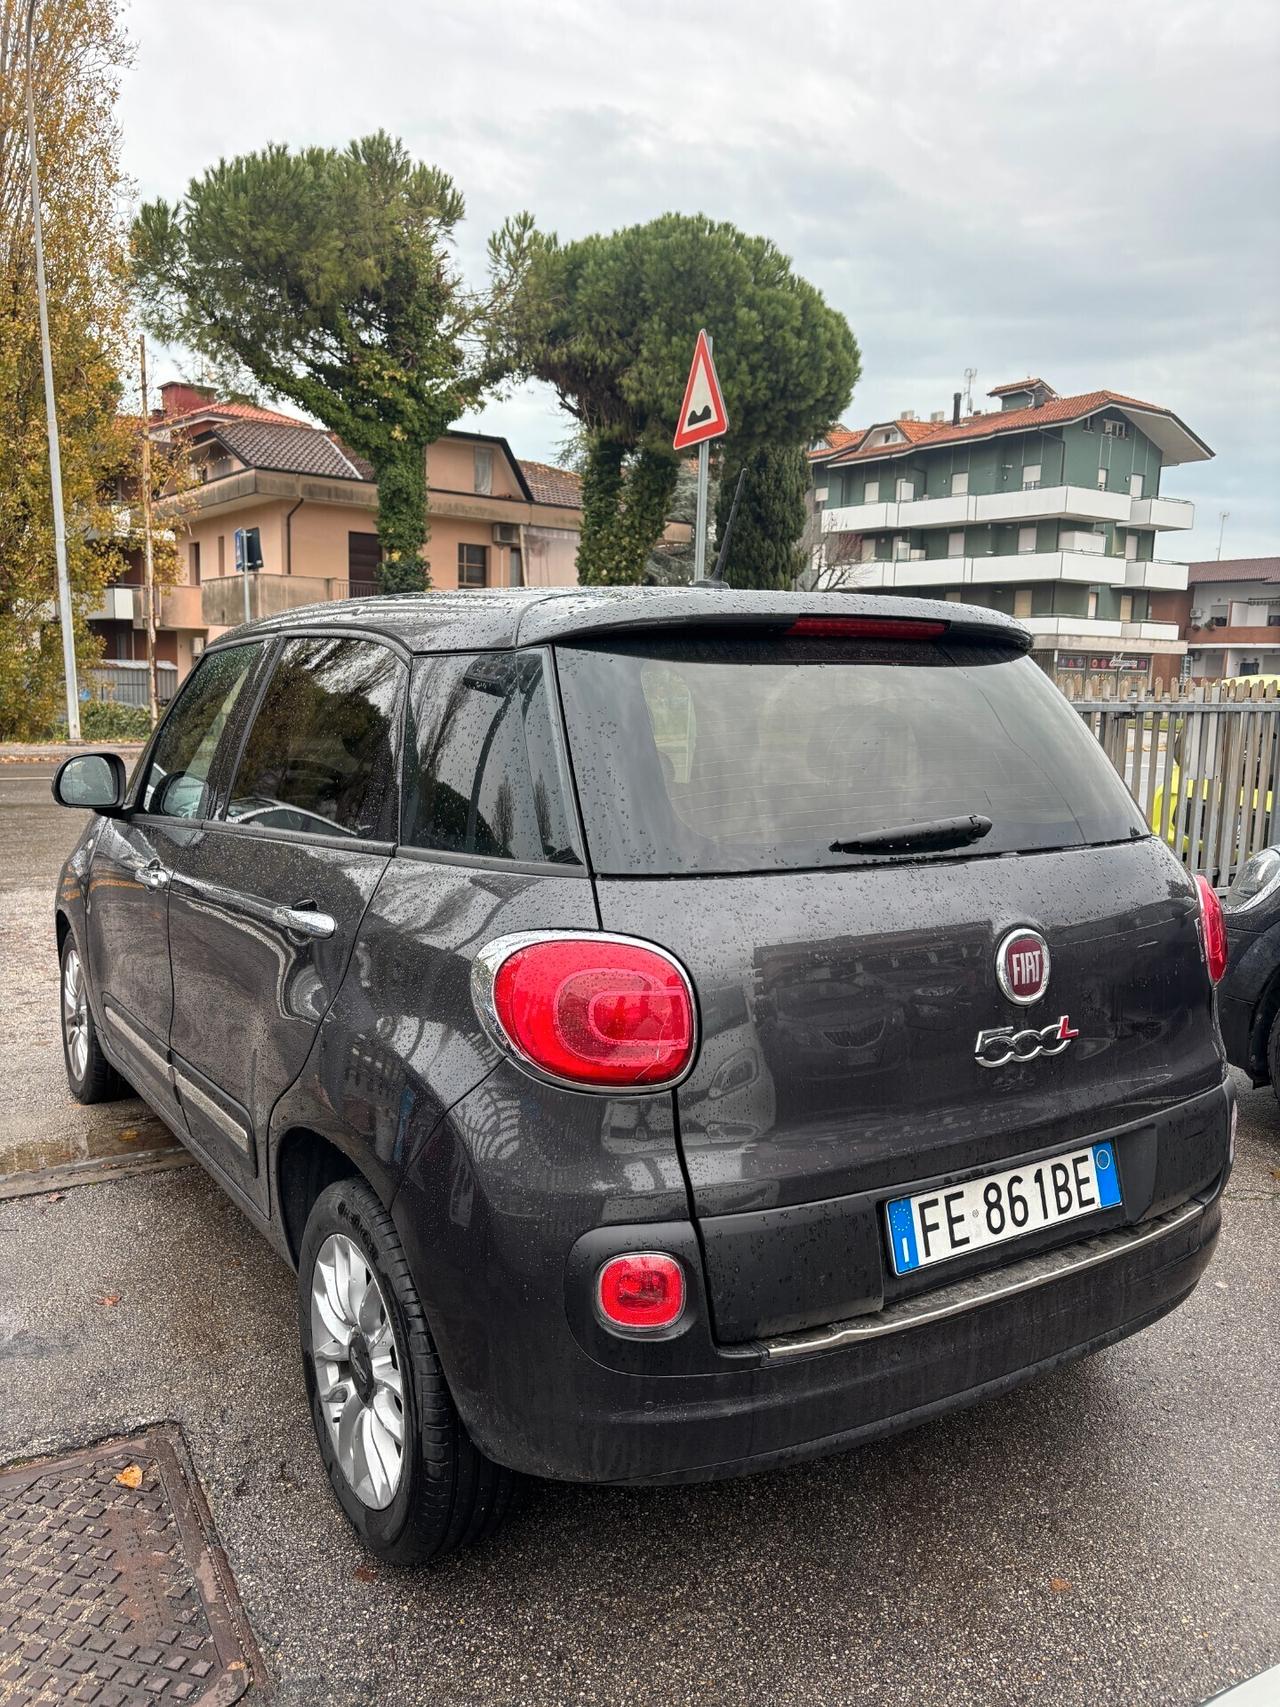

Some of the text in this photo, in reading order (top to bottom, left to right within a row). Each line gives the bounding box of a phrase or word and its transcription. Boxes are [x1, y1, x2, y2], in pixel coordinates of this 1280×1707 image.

[1012, 950, 1042, 986] FIAT
[974, 1015, 1079, 1068] 500L
[918, 1190, 971, 1258] FE
[983, 1155, 1096, 1235] 861BE
